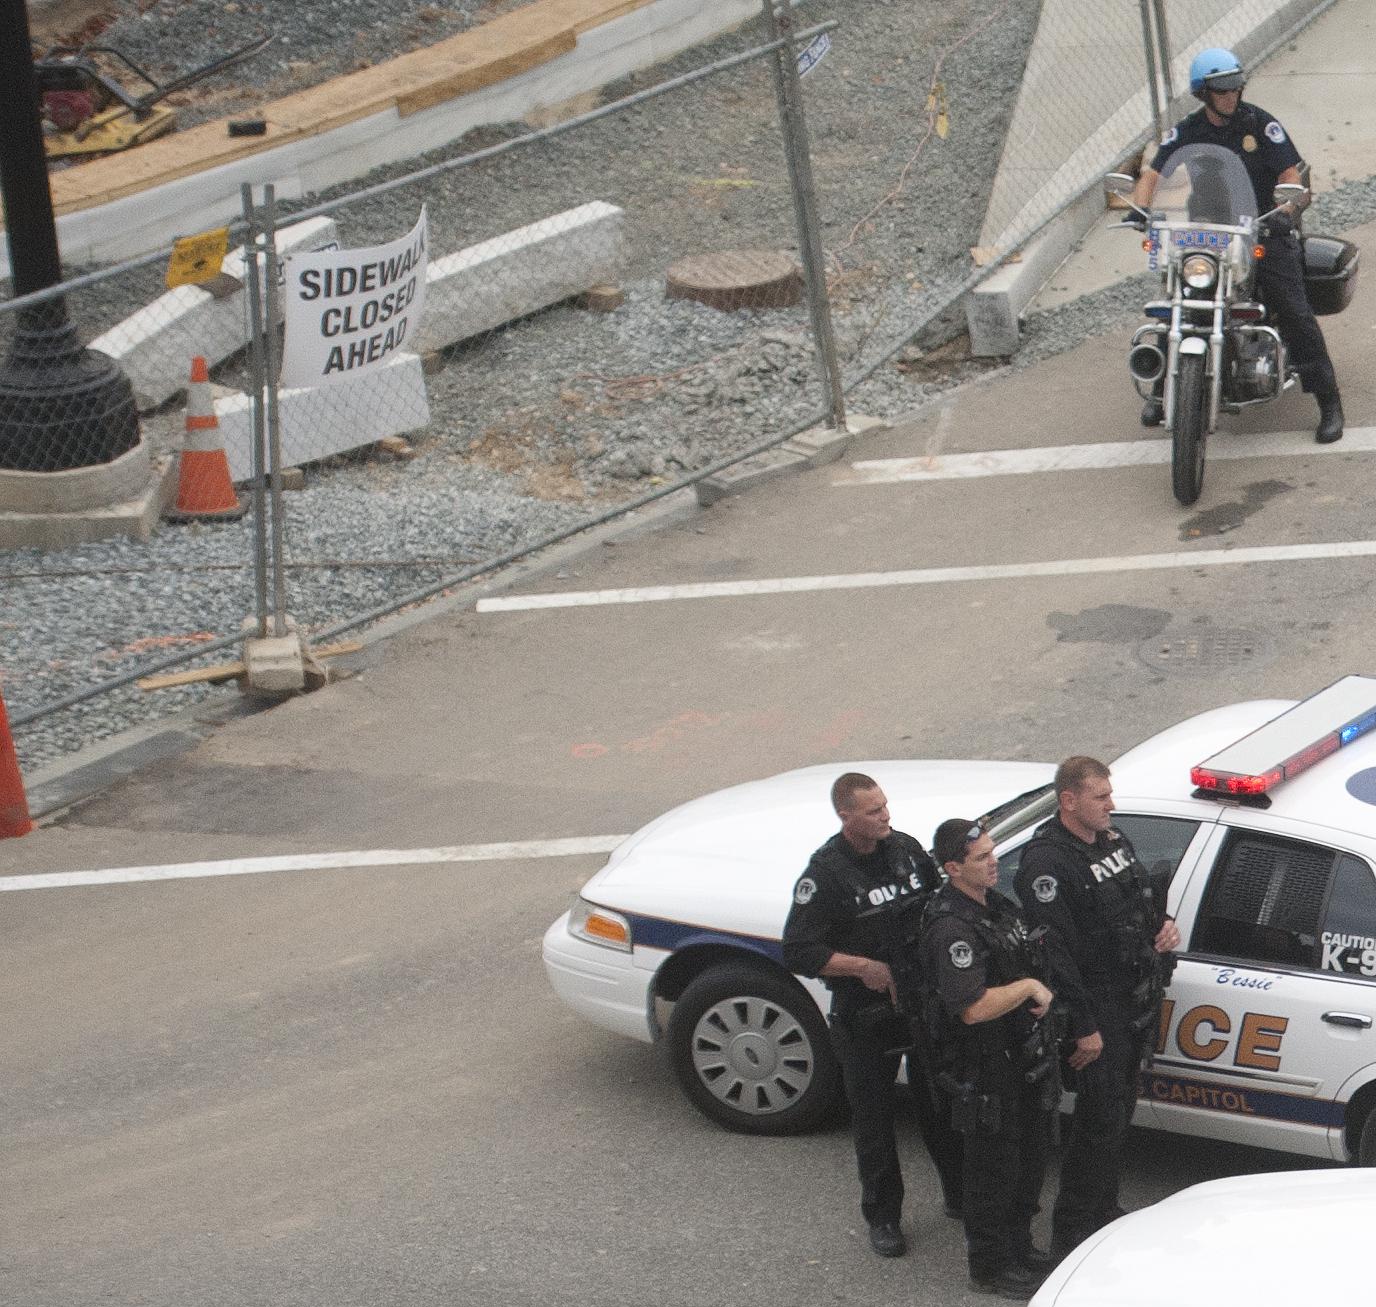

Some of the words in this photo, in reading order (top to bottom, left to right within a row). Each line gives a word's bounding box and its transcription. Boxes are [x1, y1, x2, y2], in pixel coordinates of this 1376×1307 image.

[299, 235, 426, 301] SIDEWALK
[320, 275, 417, 338] CLOSED
[321, 316, 408, 375] AHEAD
[1155, 999, 1290, 1072] ICE
[1152, 1080, 1254, 1112] CAPITOL
